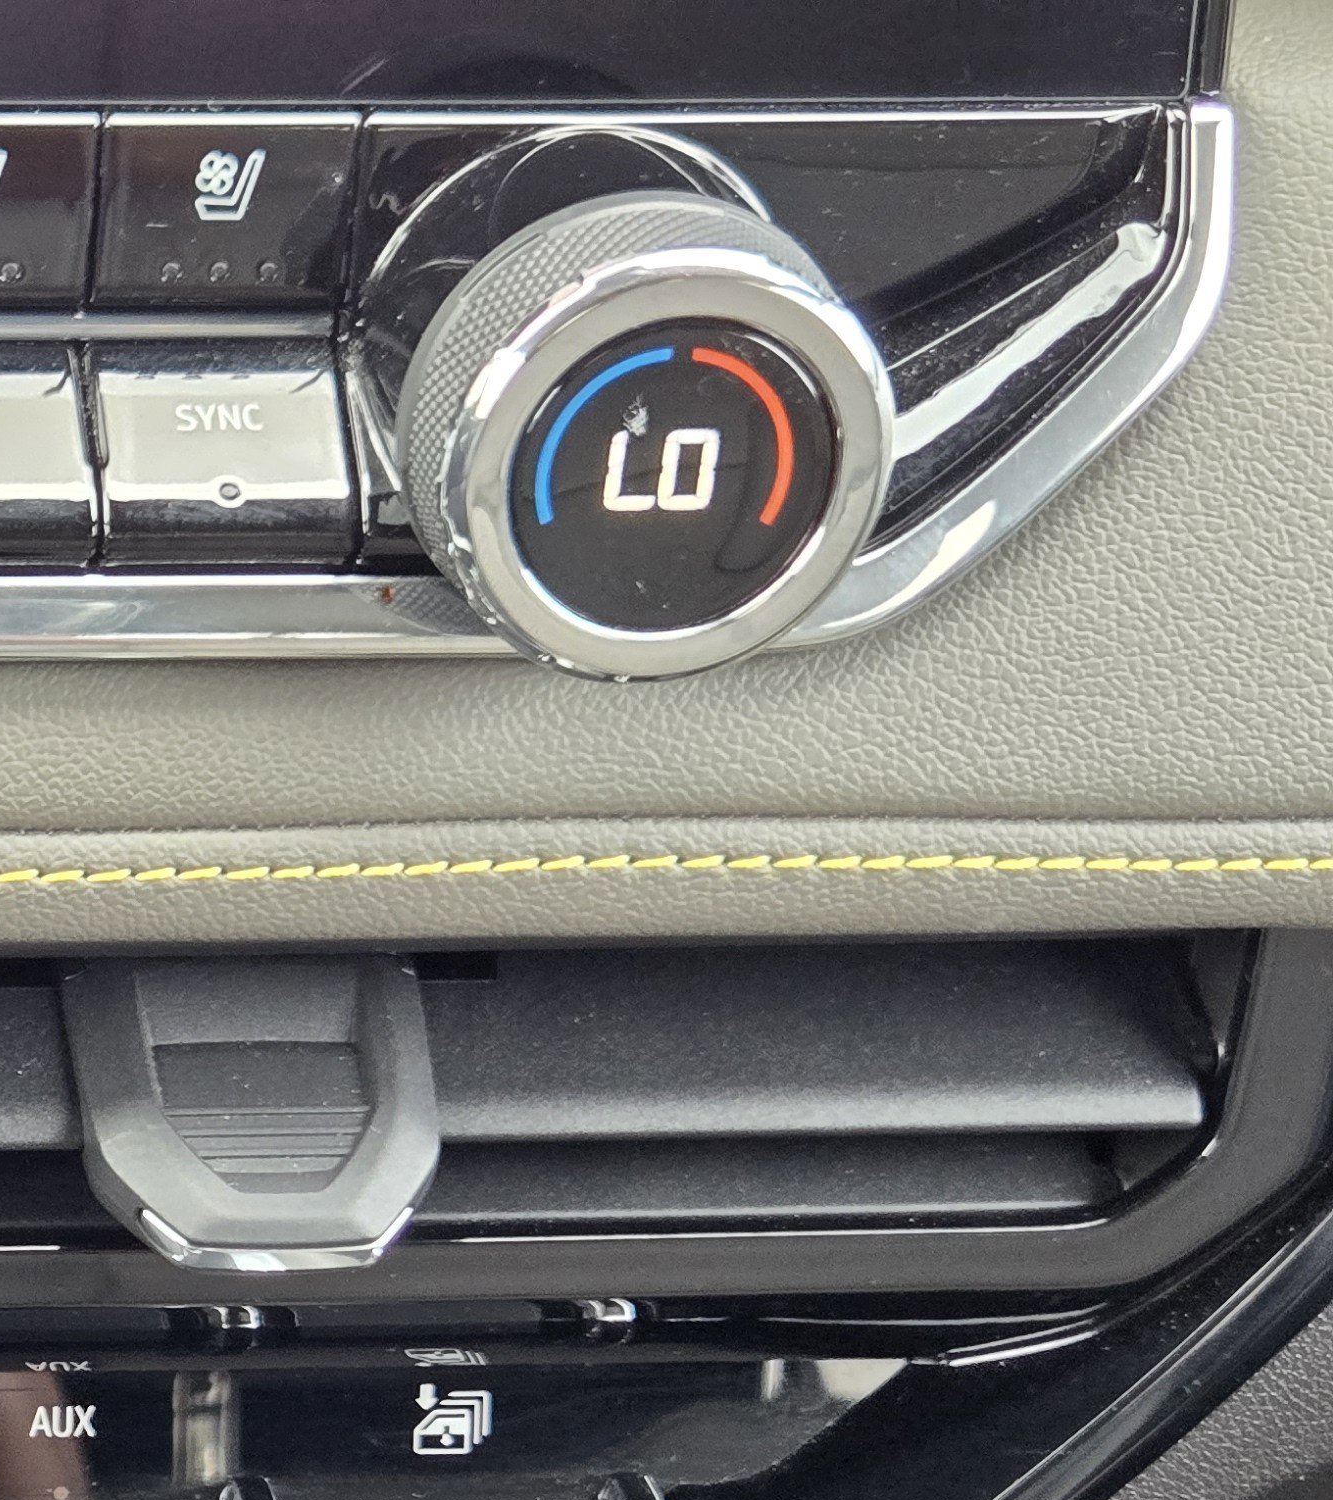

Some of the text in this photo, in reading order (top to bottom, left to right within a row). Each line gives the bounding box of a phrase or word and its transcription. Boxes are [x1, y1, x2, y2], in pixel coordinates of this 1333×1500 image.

[174, 403, 264, 432] SYNC
[602, 428, 720, 511] LO
[29, 1405, 96, 1437] AUX
